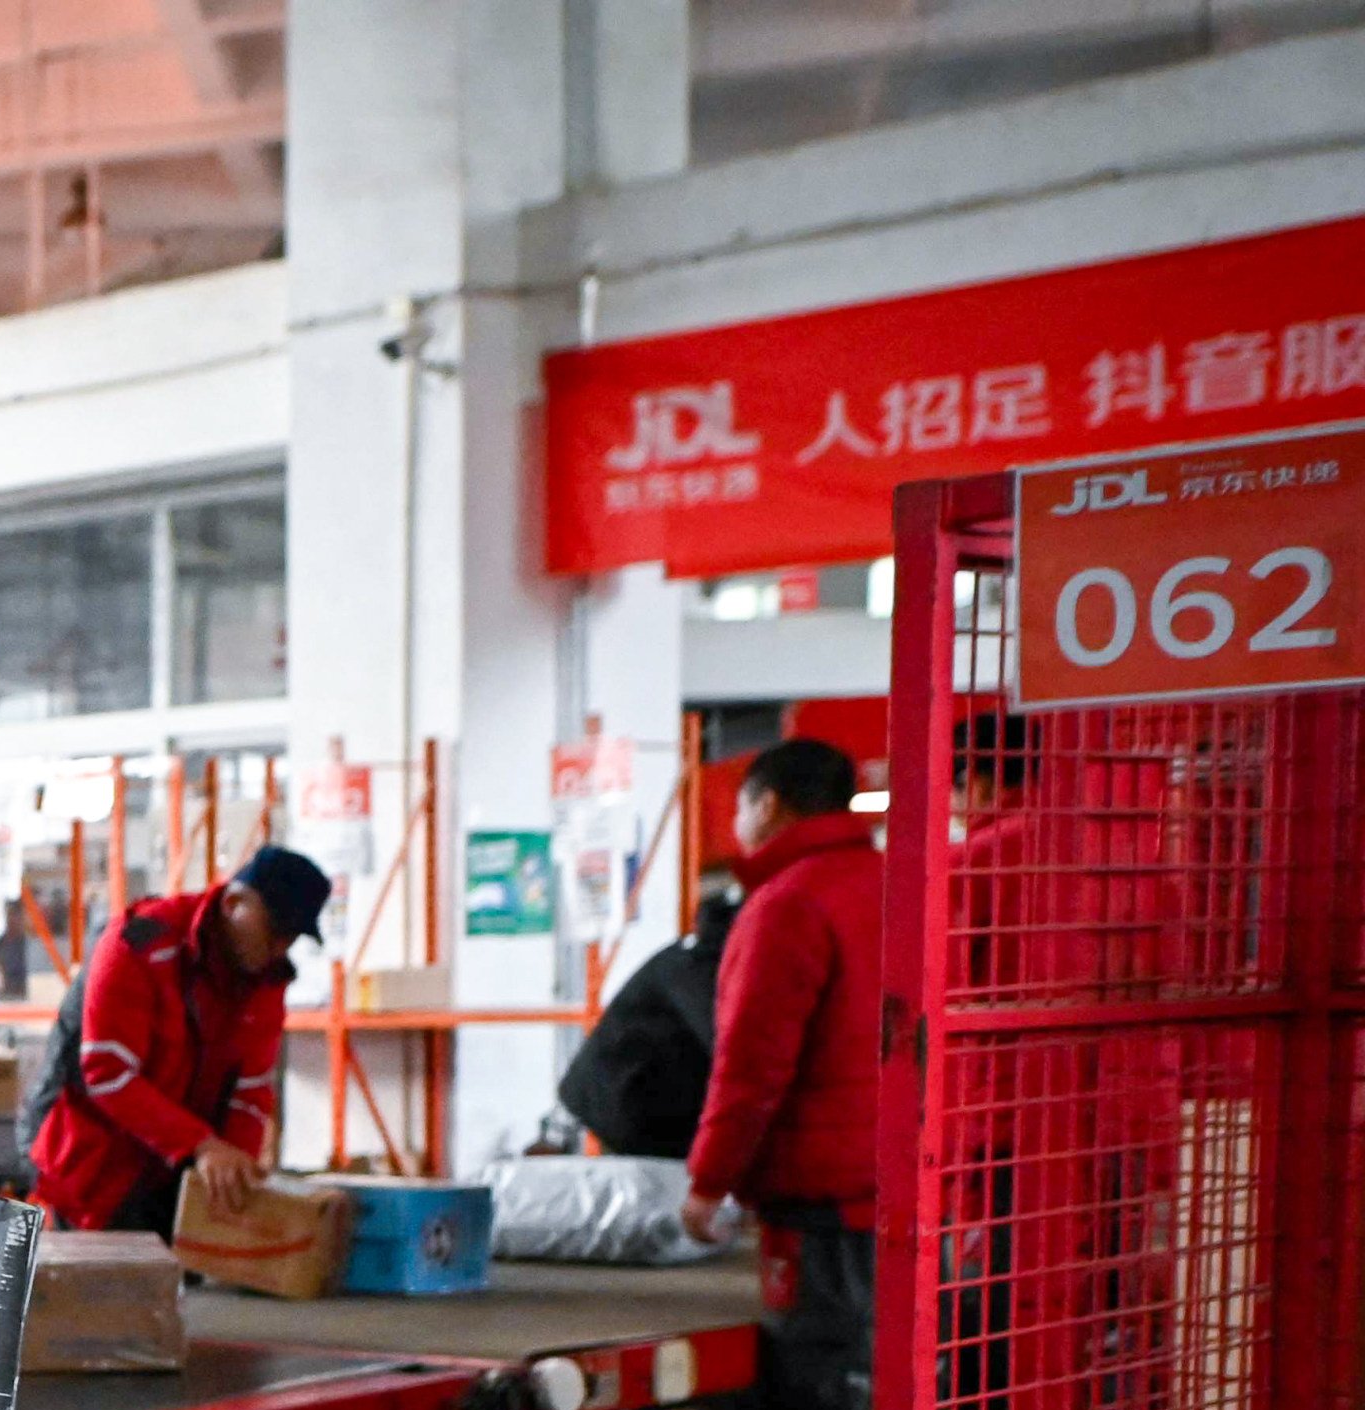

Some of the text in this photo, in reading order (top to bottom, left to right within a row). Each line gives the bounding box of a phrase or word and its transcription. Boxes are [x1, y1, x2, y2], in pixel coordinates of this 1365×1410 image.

[604, 380, 761, 470] JDL
[796, 313, 1365, 467] 人招足 抖音服
[1051, 469, 1168, 516] JDL
[1180, 459, 1341, 502] 京东快递
[1055, 545, 1338, 668] 062
